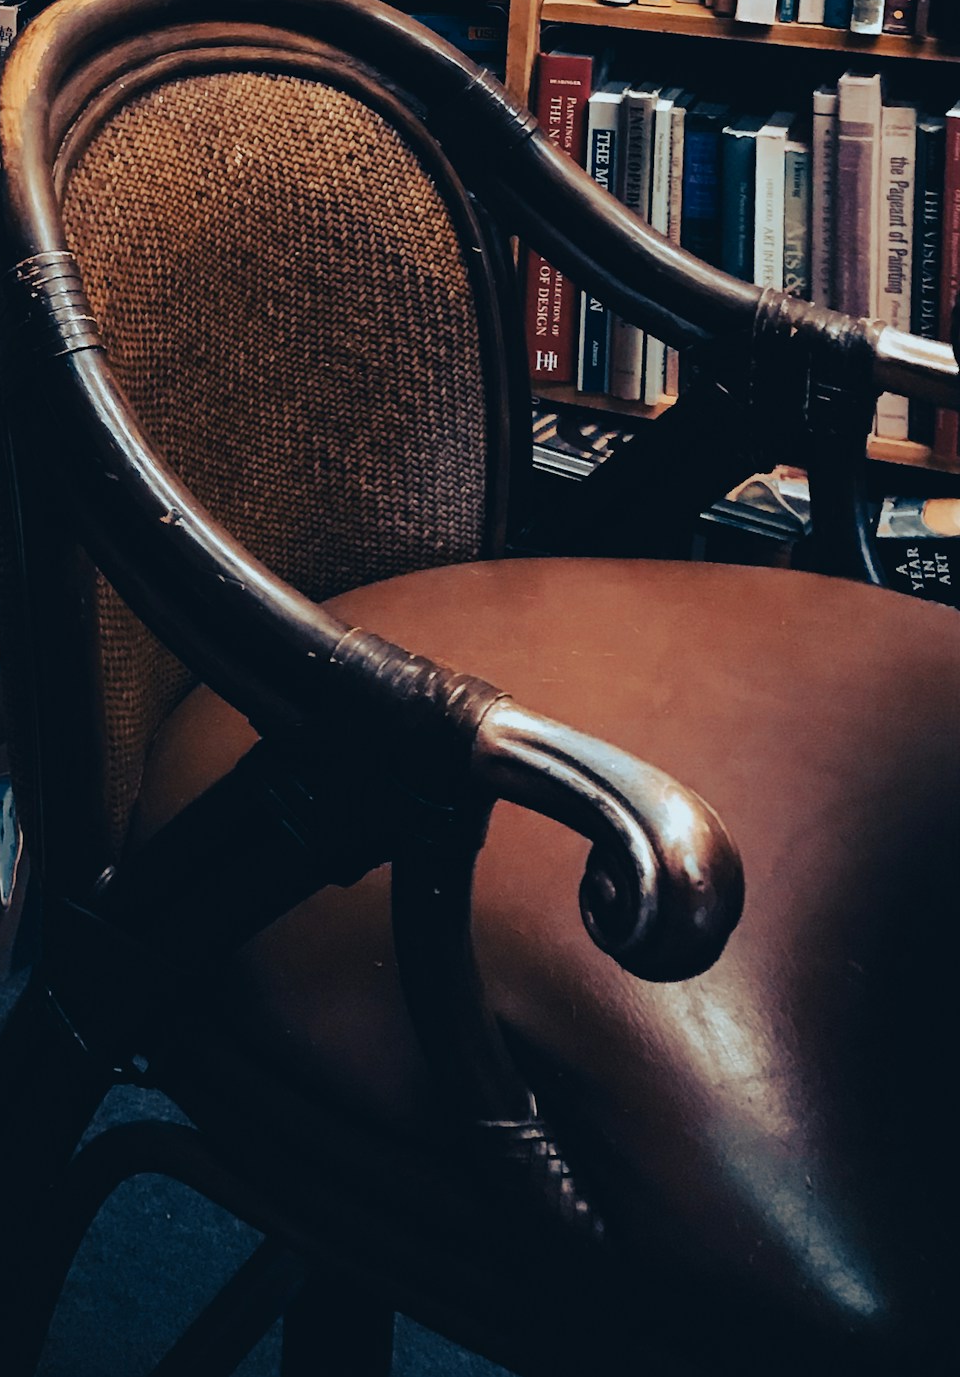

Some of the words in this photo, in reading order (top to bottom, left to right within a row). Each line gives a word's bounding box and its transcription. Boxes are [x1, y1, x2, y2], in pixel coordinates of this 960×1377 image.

[890, 157, 909, 175] the
[885, 181, 909, 227] Pageant
[924, 190, 938, 224] THE
[888, 232, 909, 244] of
[885, 249, 907, 294] Painting
[921, 232, 936, 295] VISUAL
[921, 300, 936, 338] DIA
[895, 564, 909, 576] A
[906, 547, 924, 591] YEAR
[922, 560, 936, 578] IN
[934, 552, 952, 585] ART
